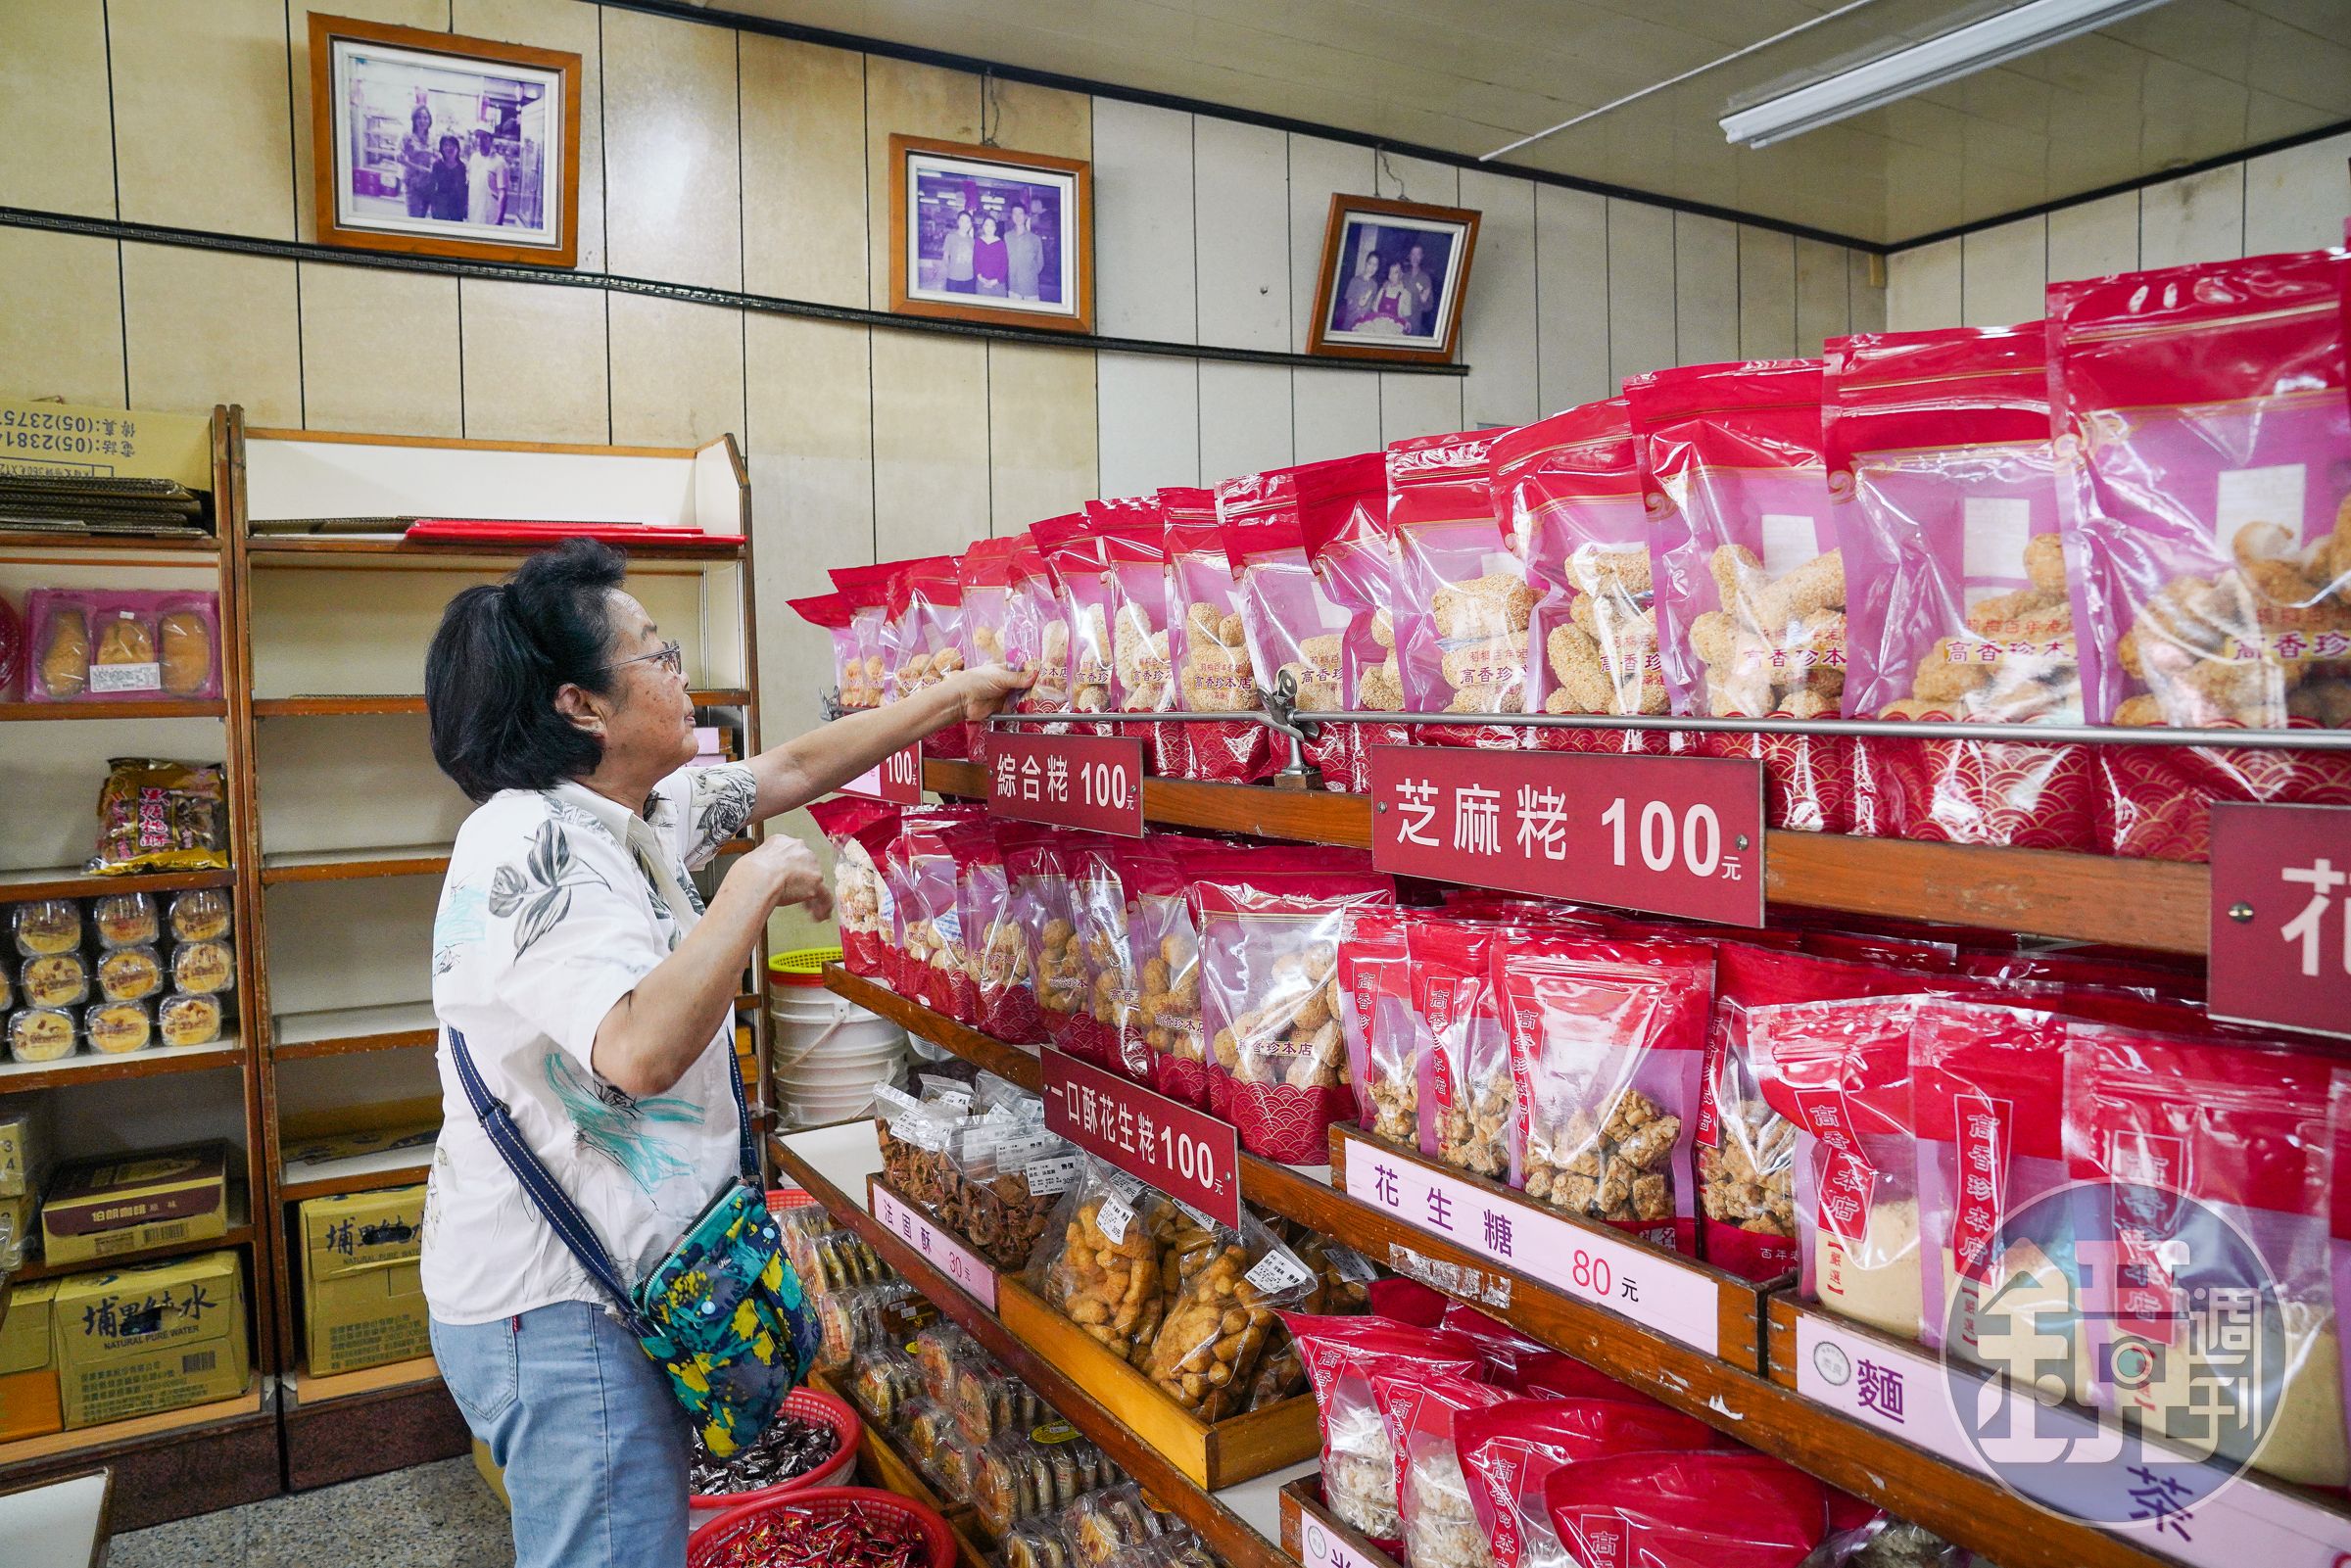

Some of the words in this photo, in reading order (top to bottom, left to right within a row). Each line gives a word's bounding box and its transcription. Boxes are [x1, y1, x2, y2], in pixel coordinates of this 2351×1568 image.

[0, 409, 135, 438] 傳真:(05)2375
[0, 431, 135, 457] 電話:(05)2381
[1945, 641, 2079, 663] 高香珍本
[1194, 676, 1253, 689] 高香珍本店
[1109, 989, 1139, 1002] 高香
[1958, 1114, 2000, 1266] 高香珍本店
[1374, 1164, 1512, 1258] 花生糖
[104, 1334, 144, 1351] NATURAL
[146, 1330, 169, 1343] PURE
[170, 1324, 200, 1338] WATER
